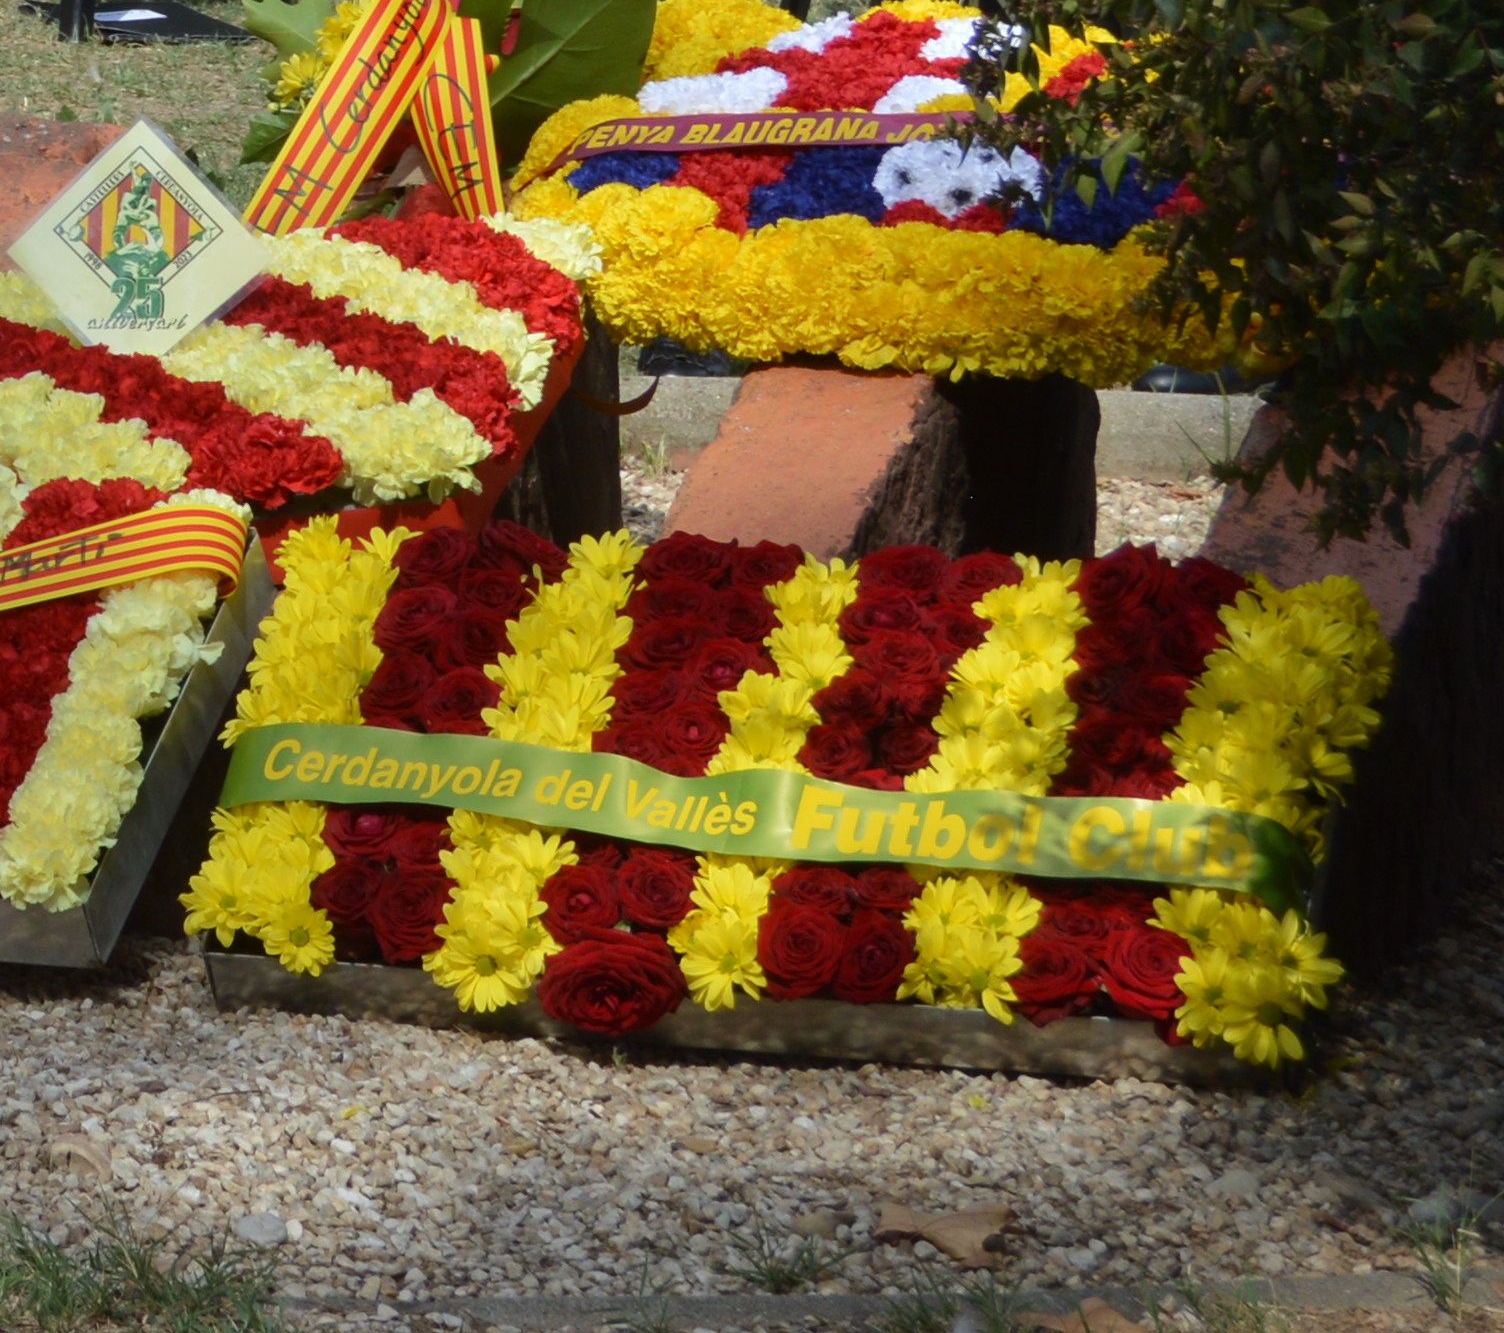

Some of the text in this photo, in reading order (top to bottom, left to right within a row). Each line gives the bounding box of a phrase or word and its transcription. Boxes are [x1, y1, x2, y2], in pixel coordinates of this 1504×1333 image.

[571, 124, 677, 154] PENYA
[682, 115, 882, 145] BLAUGRANA
[110, 276, 165, 320] 25
[262, 738, 1256, 880] Cerdanyola del Vallès Futbol Club
